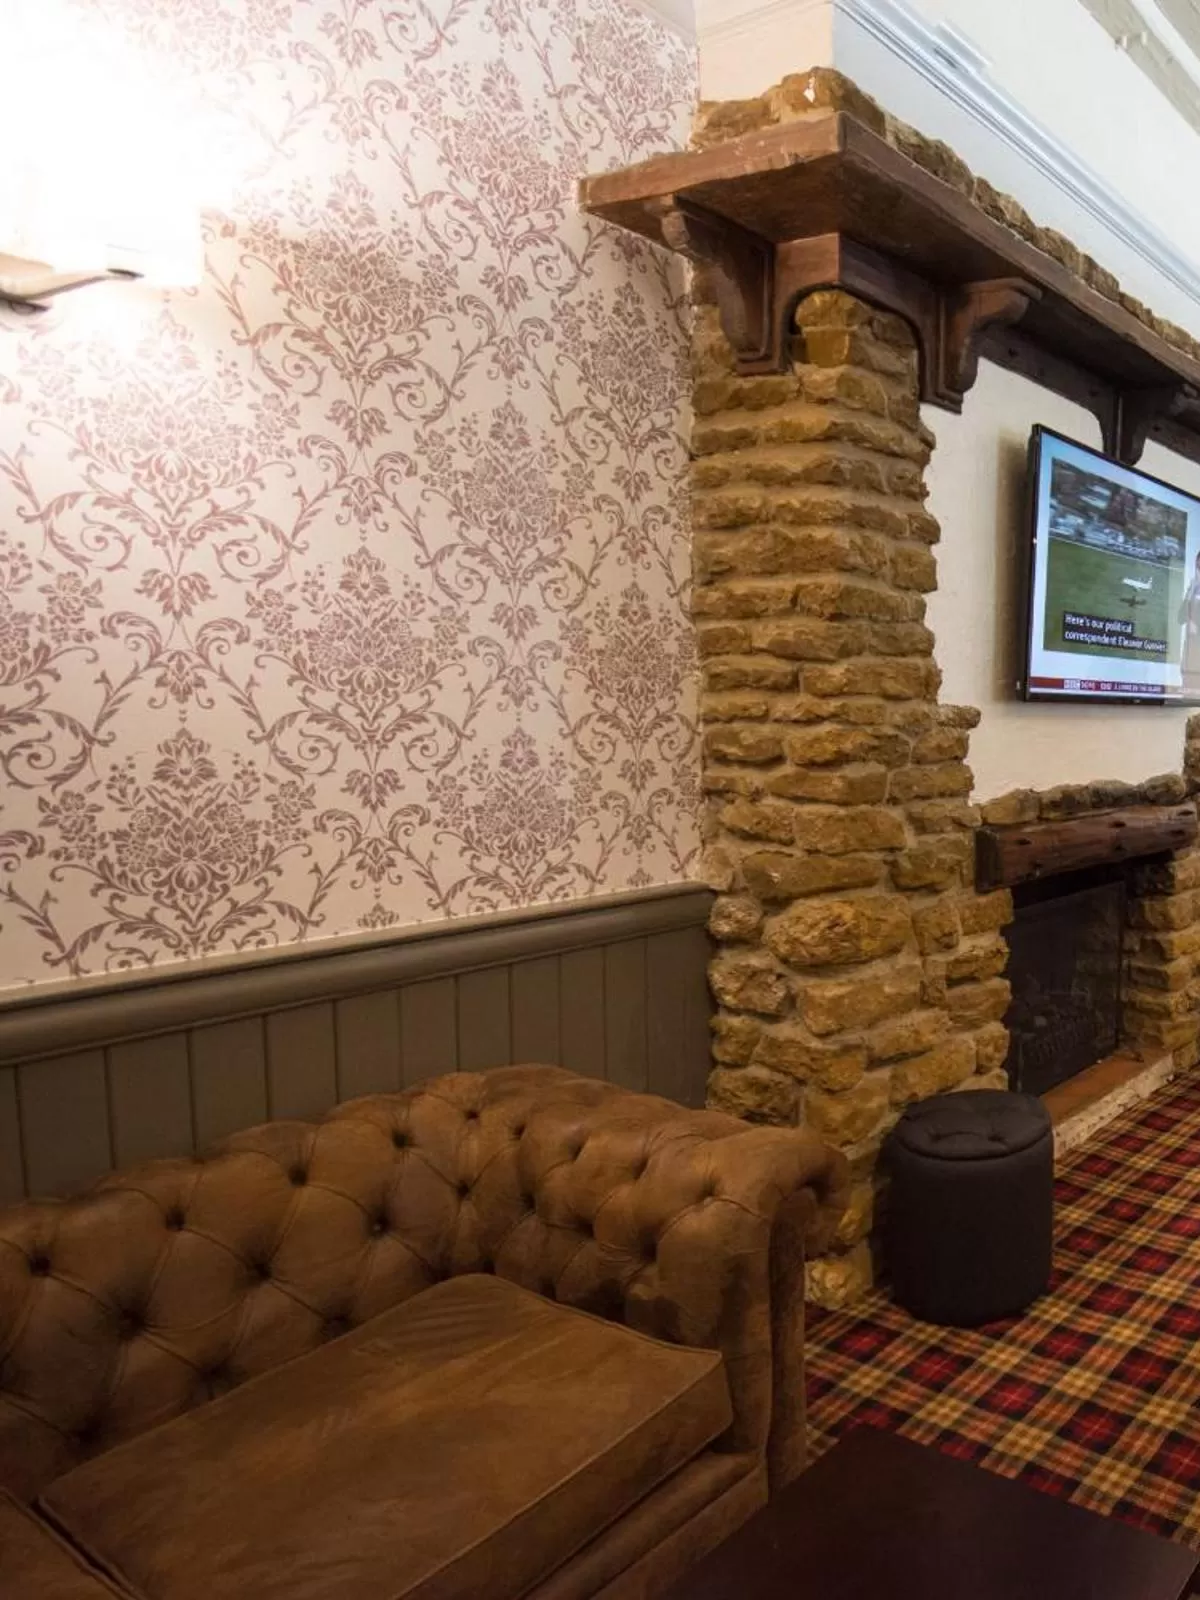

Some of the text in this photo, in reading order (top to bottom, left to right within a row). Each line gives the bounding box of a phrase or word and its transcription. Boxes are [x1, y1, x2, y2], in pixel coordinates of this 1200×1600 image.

[1065, 614, 1132, 633] Here's our political
[1065, 631, 1116, 645] correspondent
